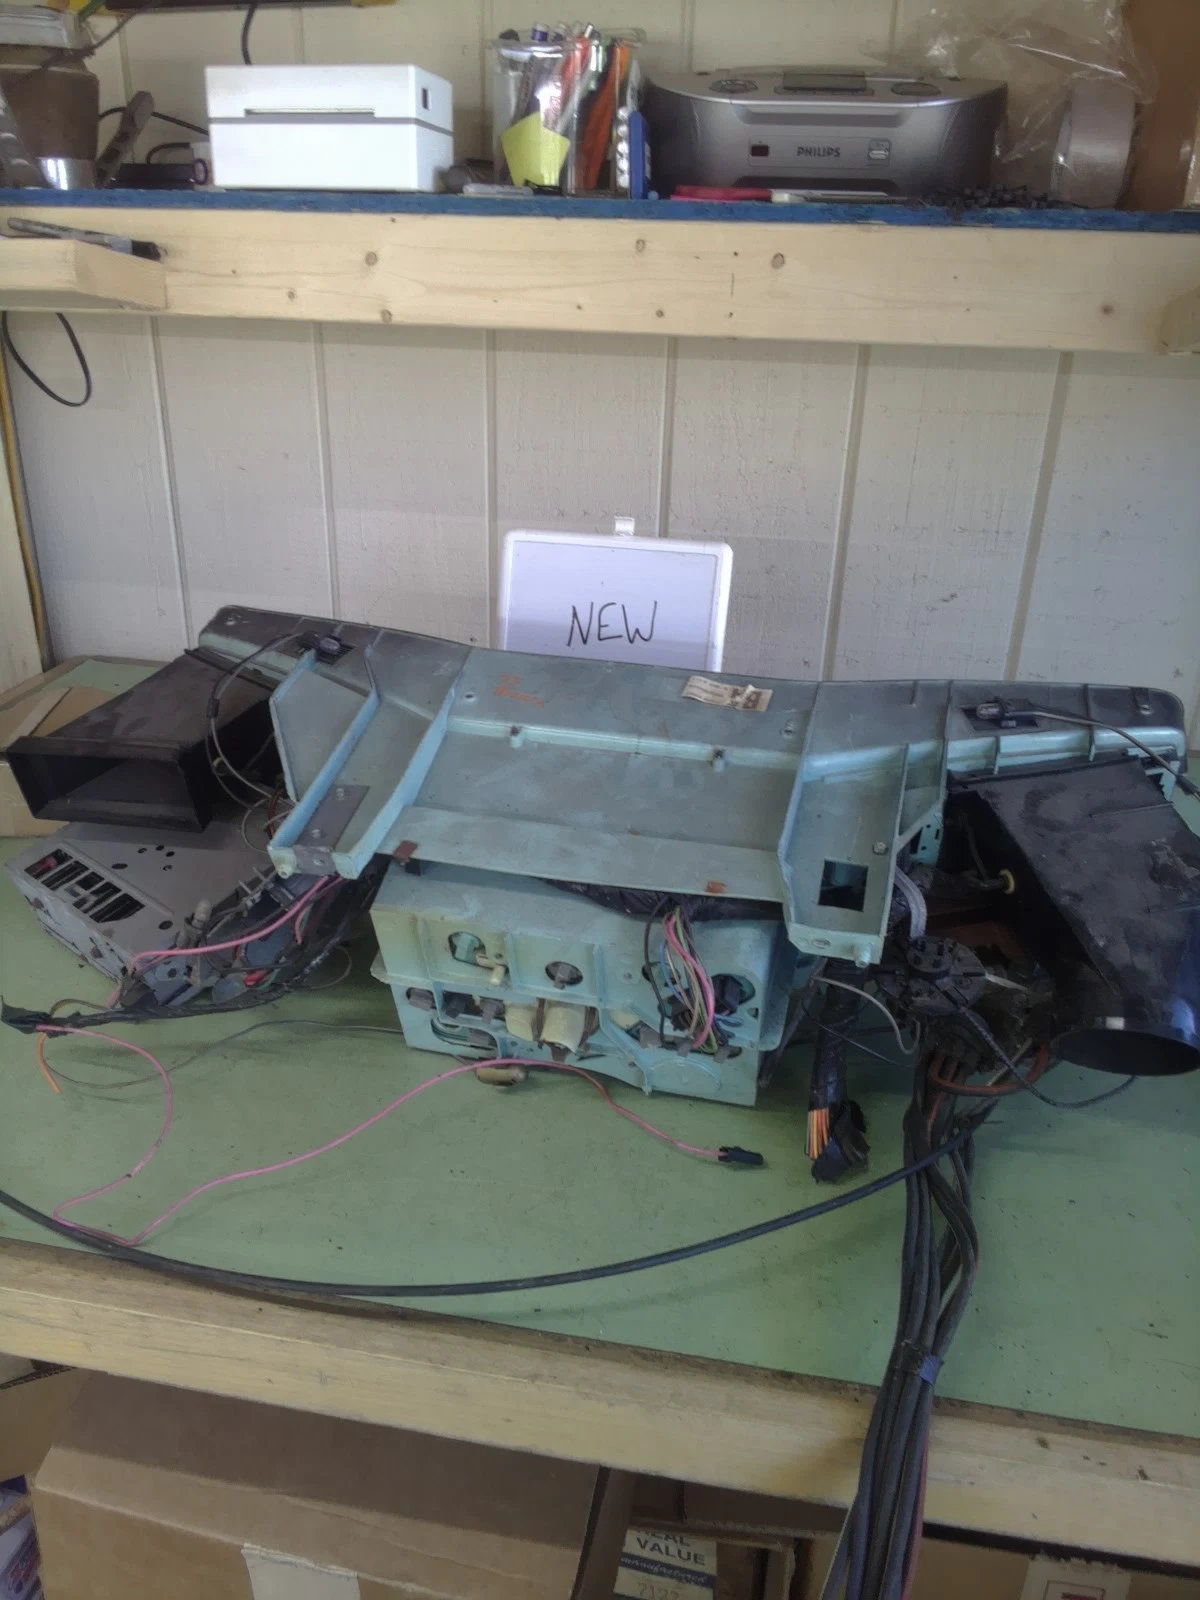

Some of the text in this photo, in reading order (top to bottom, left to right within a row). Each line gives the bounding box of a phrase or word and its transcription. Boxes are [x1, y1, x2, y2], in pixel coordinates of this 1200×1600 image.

[797, 146, 841, 158] PHILIPS
[566, 600, 657, 647] NEW
[637, 1537, 705, 1566] VALUE
